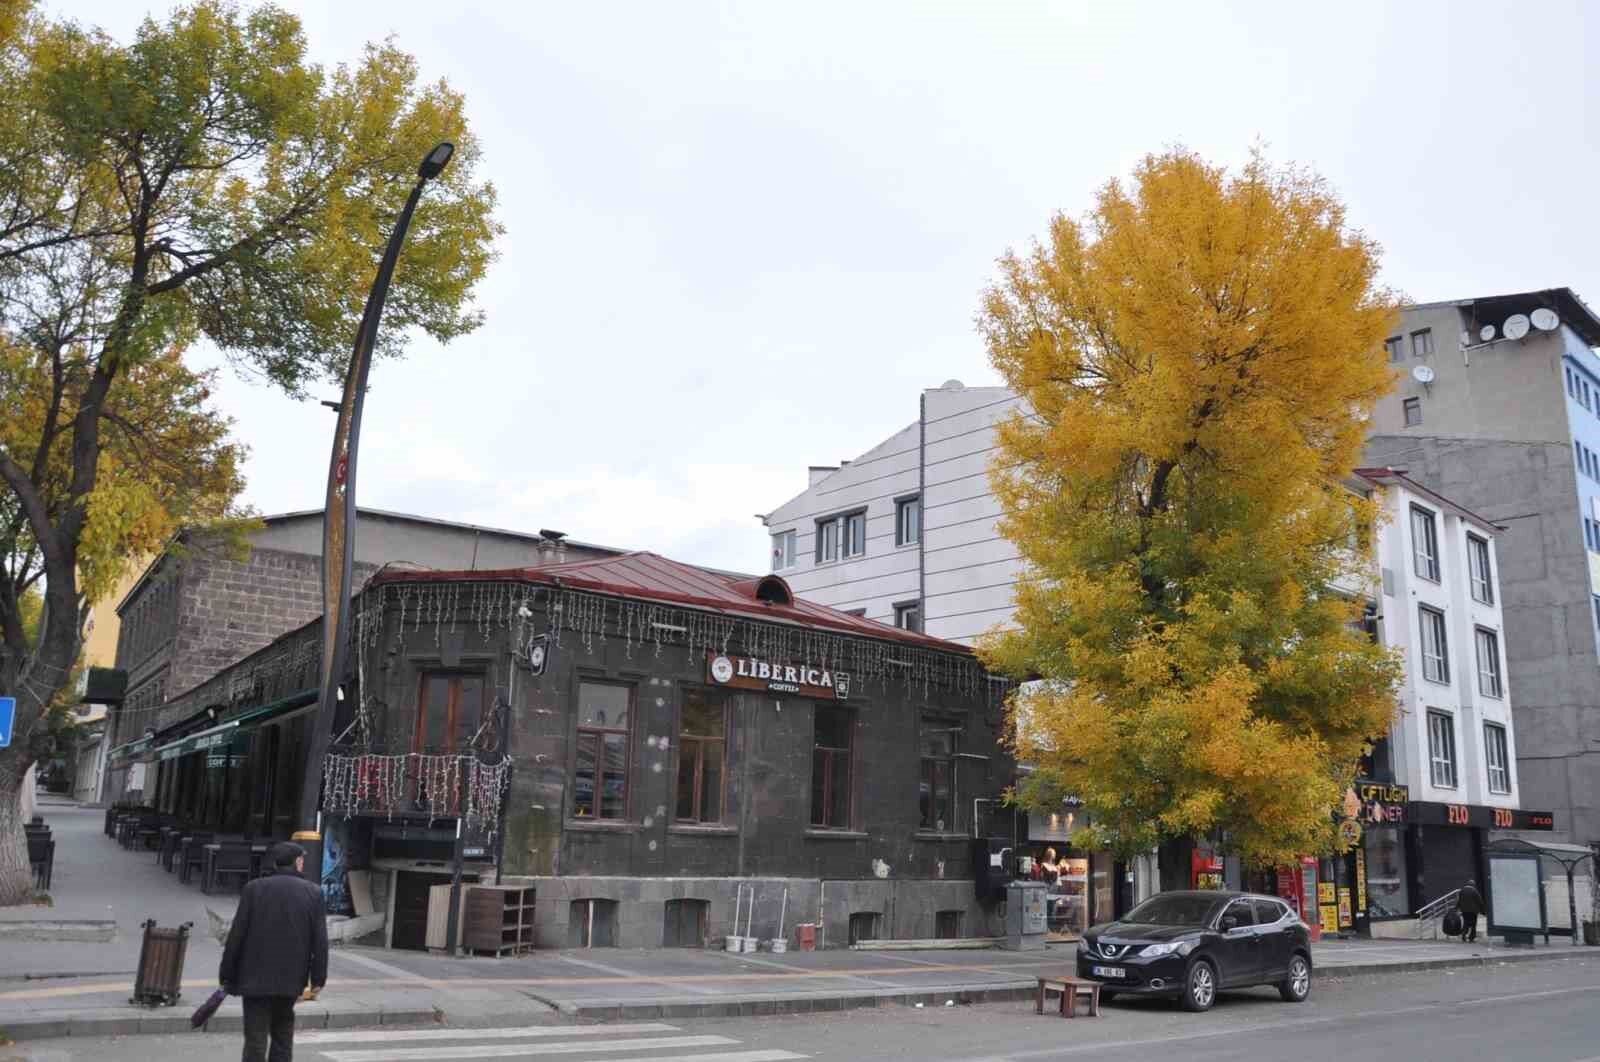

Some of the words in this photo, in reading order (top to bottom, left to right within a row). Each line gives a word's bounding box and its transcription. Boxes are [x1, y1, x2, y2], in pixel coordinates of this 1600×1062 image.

[1367, 804, 1402, 823] DNER
[1448, 805, 1469, 825] FLO
[1495, 808, 1512, 827] FLO
[1533, 816, 1552, 824] FLO
